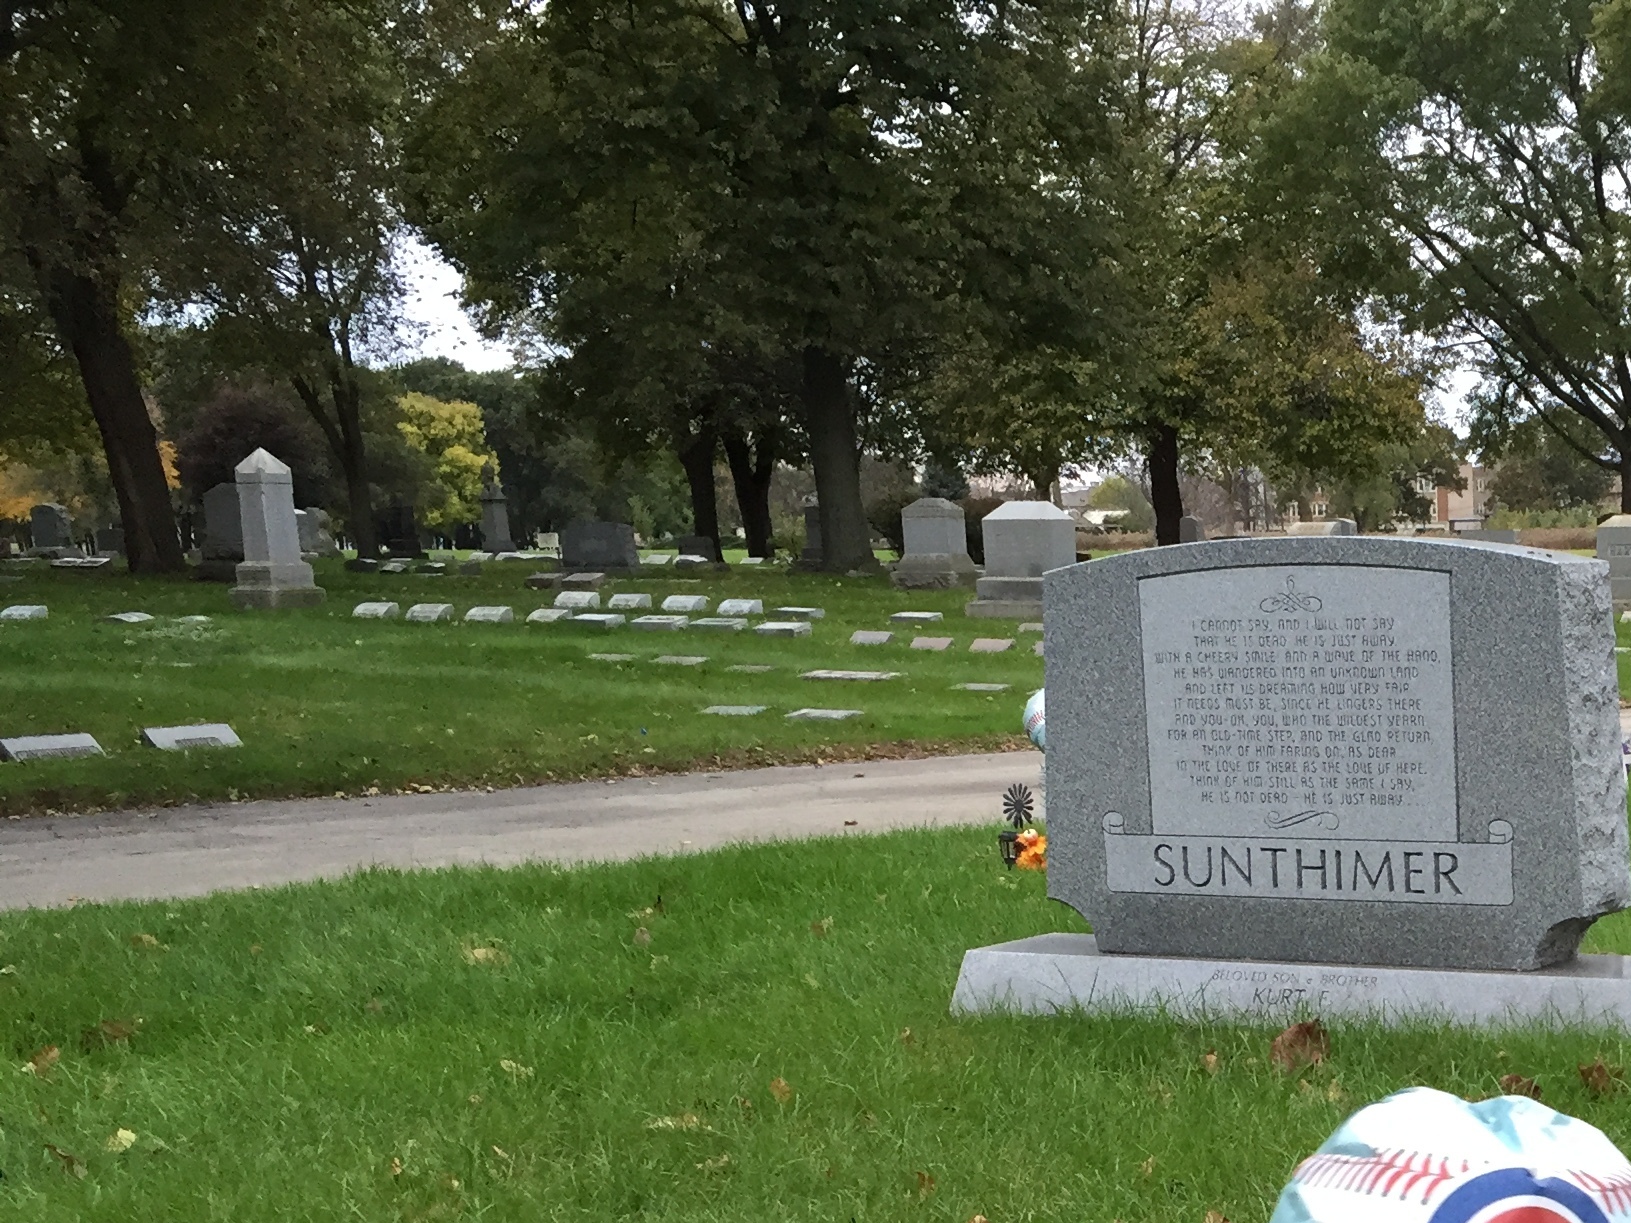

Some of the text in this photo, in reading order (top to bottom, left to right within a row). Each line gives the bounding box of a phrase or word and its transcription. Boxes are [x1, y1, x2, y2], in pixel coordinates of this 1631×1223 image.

[1201, 619, 1242, 632] CANNOT
[1278, 619, 1300, 629] AND
[1315, 618, 1338, 630] WILL
[1345, 617, 1366, 630] NOT
[1373, 617, 1394, 630] SAY
[1194, 636, 1218, 647] THAT
[1225, 636, 1237, 647] HE
[1243, 636, 1252, 647] IS
[1296, 635, 1308, 646] HE
[1315, 635, 1325, 647] IS
[1332, 635, 1356, 647] JUST
[1155, 652, 1180, 663] WITH
[1185, 652, 1192, 663] A
[1198, 652, 1238, 663] CHEERY
[1285, 651, 1307, 662] AND
[1313, 651, 1319, 661] A
[1325, 650, 1355, 662] WAVE
[1362, 650, 1374, 662] OF
[1382, 650, 1400, 662] THE
[1174, 666, 1419, 679] HE HAS WANDERED INTO AN UNKNOWN LAND
[1185, 683, 1206, 694] AND
[1211, 683, 1234, 694] LEFT
[1241, 684, 1254, 695] US
[1259, 683, 1315, 695] DREAMING
[1321, 682, 1345, 695] HOW
[1351, 683, 1379, 694] VERY
[1174, 698, 1182, 709] IT
[1187, 698, 1220, 710] NEEDS
[1226, 697, 1253, 710] MUST
[1282, 698, 1311, 710] SINCE
[1318, 698, 1330, 710] HE
[1338, 698, 1382, 710] LINGERS
[1388, 698, 1421, 710] THERE
[1175, 714, 1196, 725] AND
[1282, 714, 1306, 726] WHO
[1312, 714, 1331, 726] THE
[1337, 714, 1382, 727] WILDEST
[1168, 729, 1187, 741] FOR
[1193, 729, 1206, 740] AN
[1301, 730, 1322, 742] AND
[1328, 731, 1346, 741] THE
[1353, 731, 1381, 742] GLAD
[1202, 745, 1231, 756] THINK
[1238, 745, 1250, 756] OF
[1256, 745, 1275, 756] HIM
[1281, 745, 1320, 758] FARING
[1348, 746, 1362, 758] AS
[1368, 747, 1396, 758] DEAR
[1176, 760, 1187, 771] IN
[1192, 760, 1210, 772] THE
[1217, 760, 1240, 772] LOVE
[1247, 761, 1259, 772] OF
[1266, 761, 1297, 773] THERE
[1303, 761, 1317, 773] AS
[1322, 762, 1340, 773] THE
[1347, 762, 1372, 774] LOVE
[1378, 763, 1390, 775] OF
[1190, 775, 1219, 785] THINK
[1225, 776, 1237, 787] OF
[1243, 776, 1262, 788] HIM
[1269, 776, 1295, 788] STILL
[1301, 777, 1314, 789] AS
[1320, 777, 1338, 788] THE
[1346, 777, 1374, 789] SAME
[1201, 792, 1213, 803] HE
[1220, 791, 1230, 803] IS
[1235, 791, 1254, 804] NOT
[1260, 792, 1288, 803] DEAD
[1304, 792, 1317, 804] HE
[1323, 792, 1333, 805] IS
[1340, 793, 1365, 805] JUST
[1154, 844, 1463, 895] SUNTHIMER
[1212, 969, 1267, 983] BELOVED
[1273, 971, 1299, 984] SON
[1319, 973, 1378, 987] BROTHER
[1252, 987, 1306, 1005] KURT
